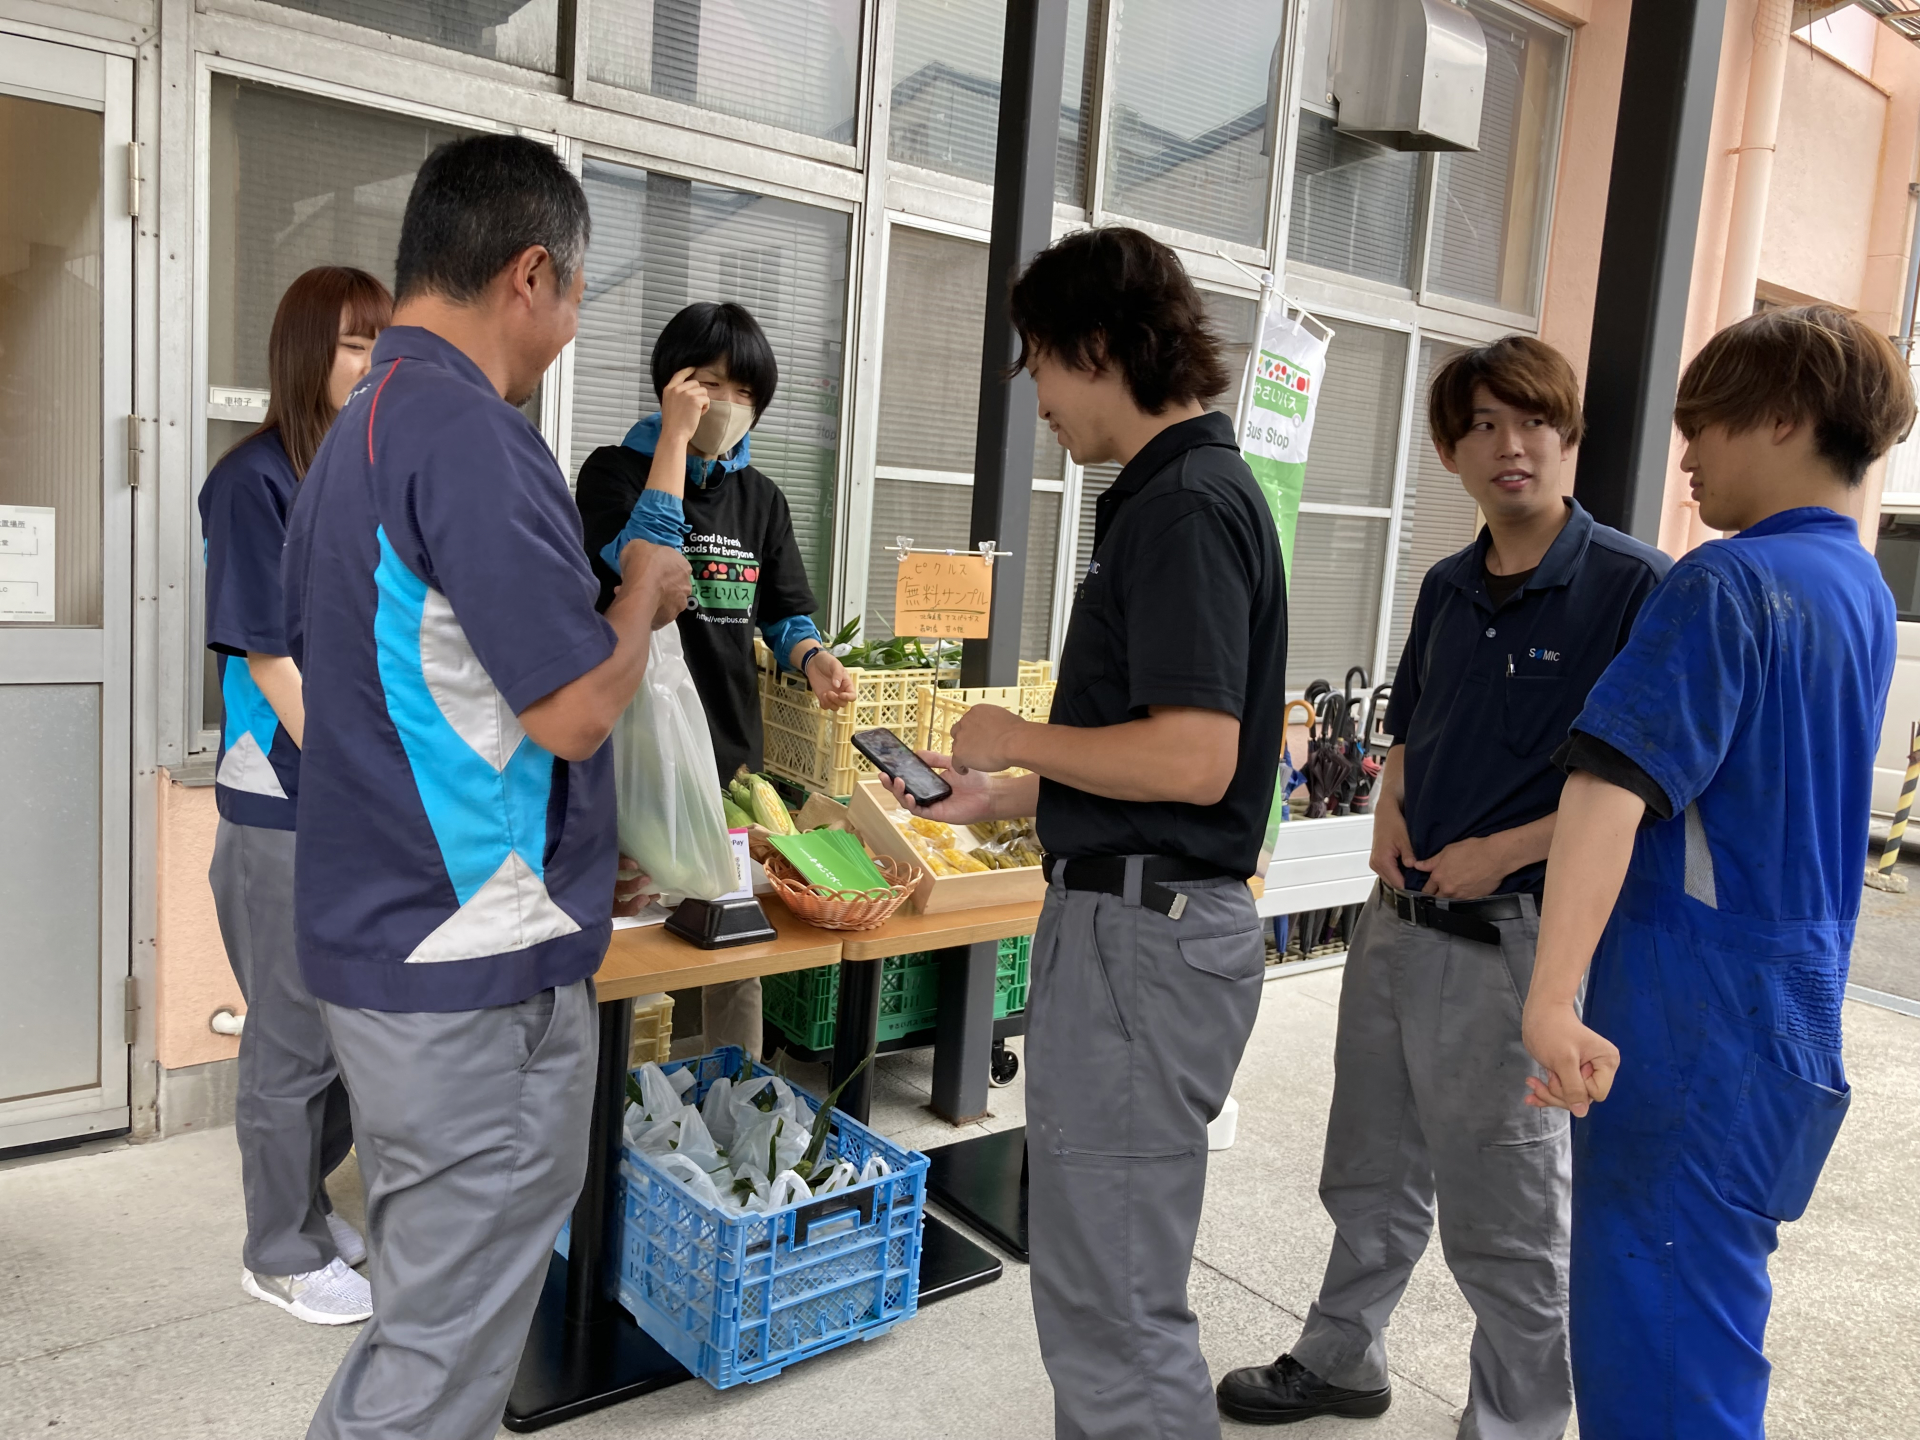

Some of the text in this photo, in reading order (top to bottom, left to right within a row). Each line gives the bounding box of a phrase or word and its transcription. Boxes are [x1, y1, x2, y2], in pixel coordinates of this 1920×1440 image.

[1254, 381, 1297, 411] やさいバス
[1265, 426, 1290, 450] Stop
[0, 519, 26, 529] 置場所
[689, 532, 716, 544] Good
[716, 534, 724, 545] &
[709, 544, 721, 555] for
[721, 546, 755, 559] Everyone
[914, 562, 968, 576] ピクルス
[904, 580, 989, 606] 無料サンプル
